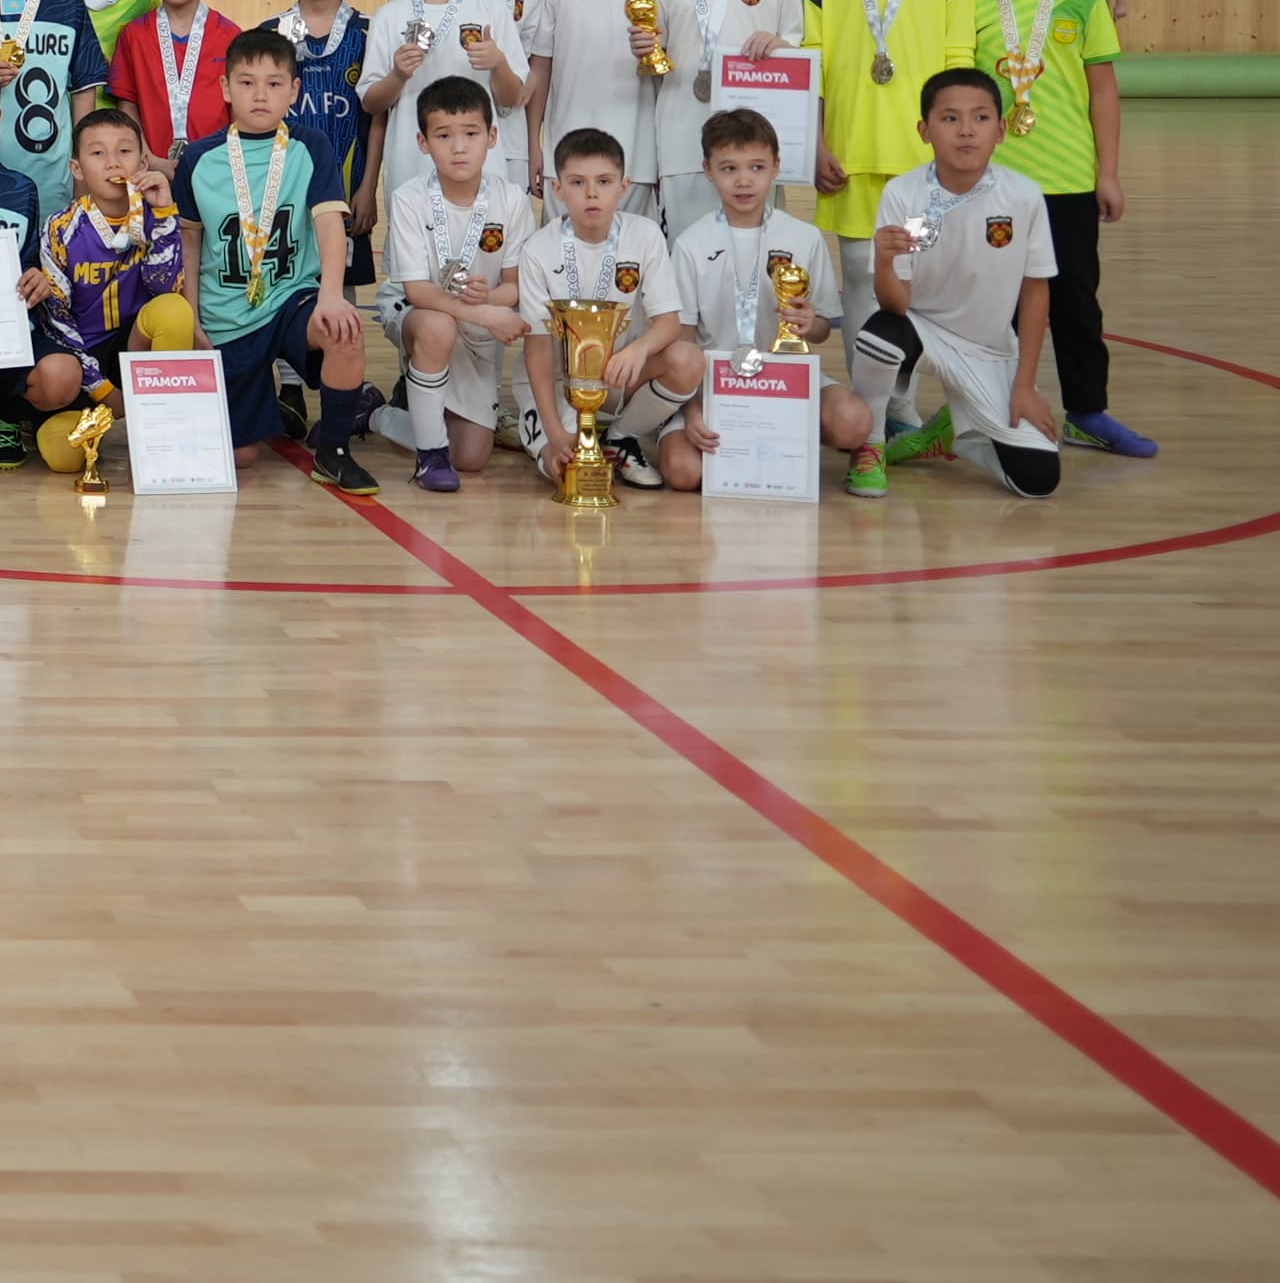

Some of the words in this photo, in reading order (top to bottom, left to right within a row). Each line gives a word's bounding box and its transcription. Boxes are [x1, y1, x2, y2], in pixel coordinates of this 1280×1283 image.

[727, 70, 789, 83] ГРАМОТА
[218, 204, 299, 289] 14
[137, 376, 197, 387] ГРАМОТА
[720, 377, 787, 391] ГРАМОТА
